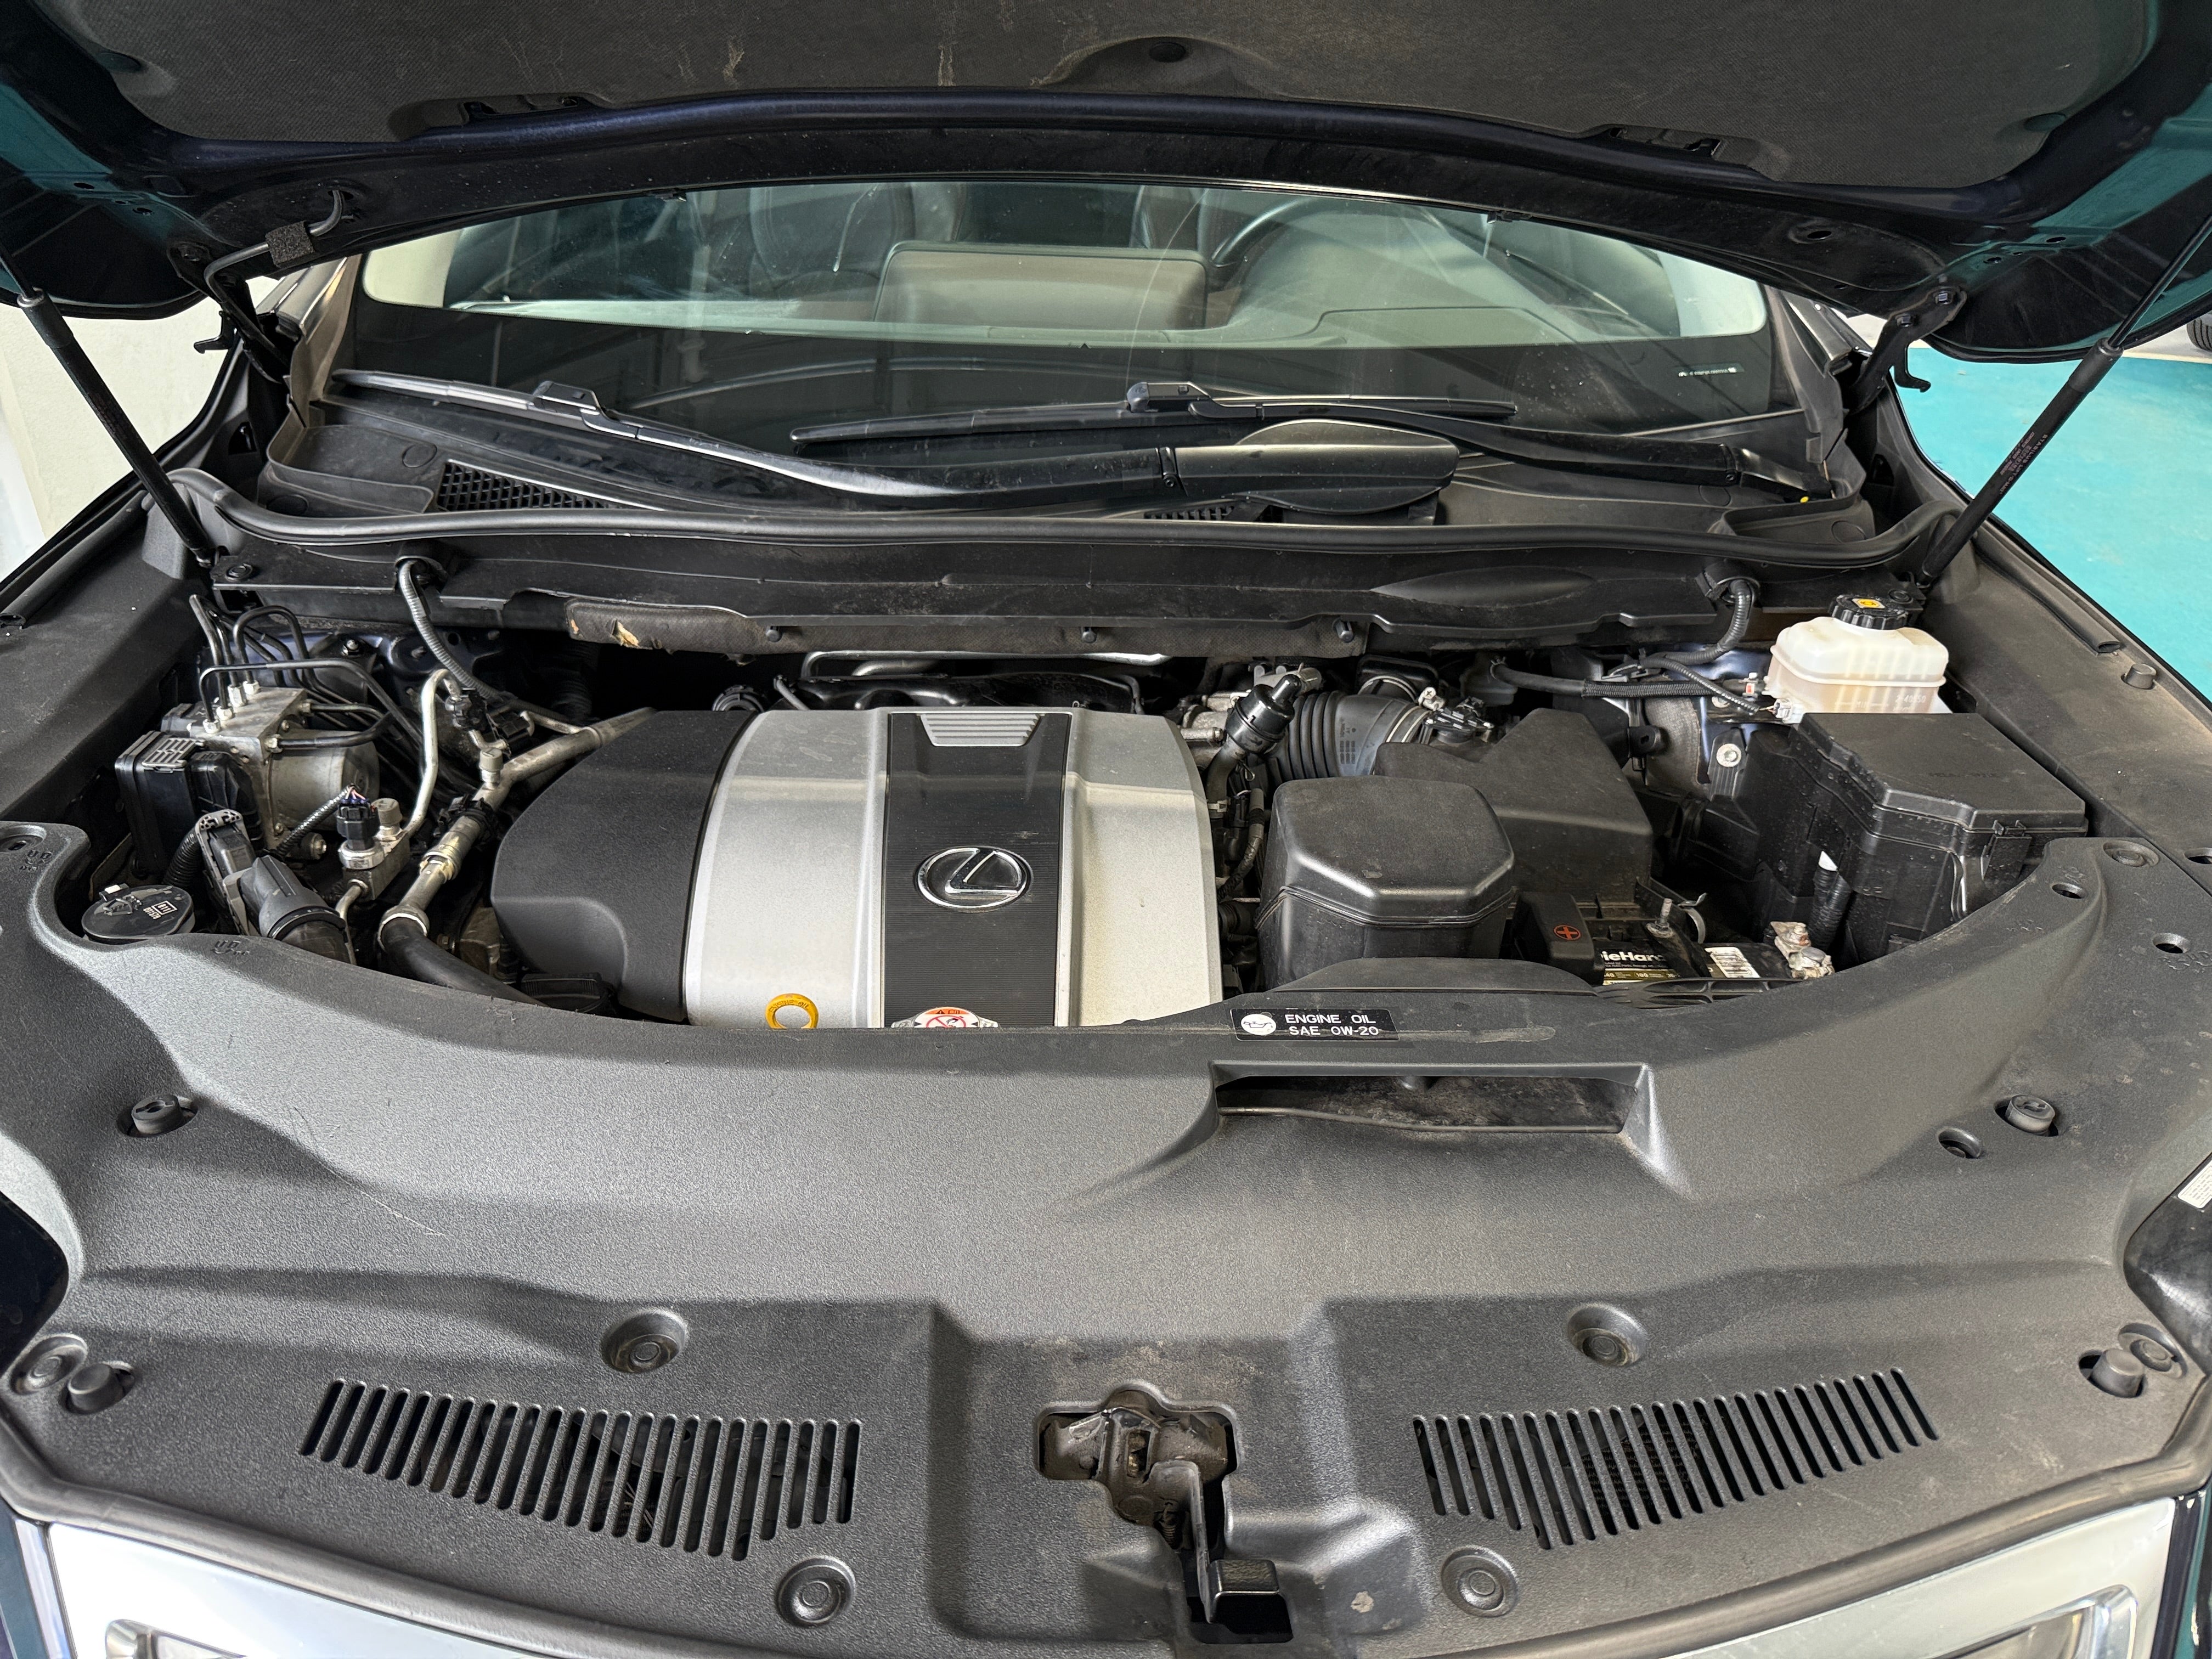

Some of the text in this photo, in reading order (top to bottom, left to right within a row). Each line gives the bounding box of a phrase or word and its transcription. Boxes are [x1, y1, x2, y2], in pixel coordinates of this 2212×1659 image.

[1285, 1014, 1376, 1024] ENGINE OIL
[1290, 1026, 1379, 1036] SAE 0W-20
